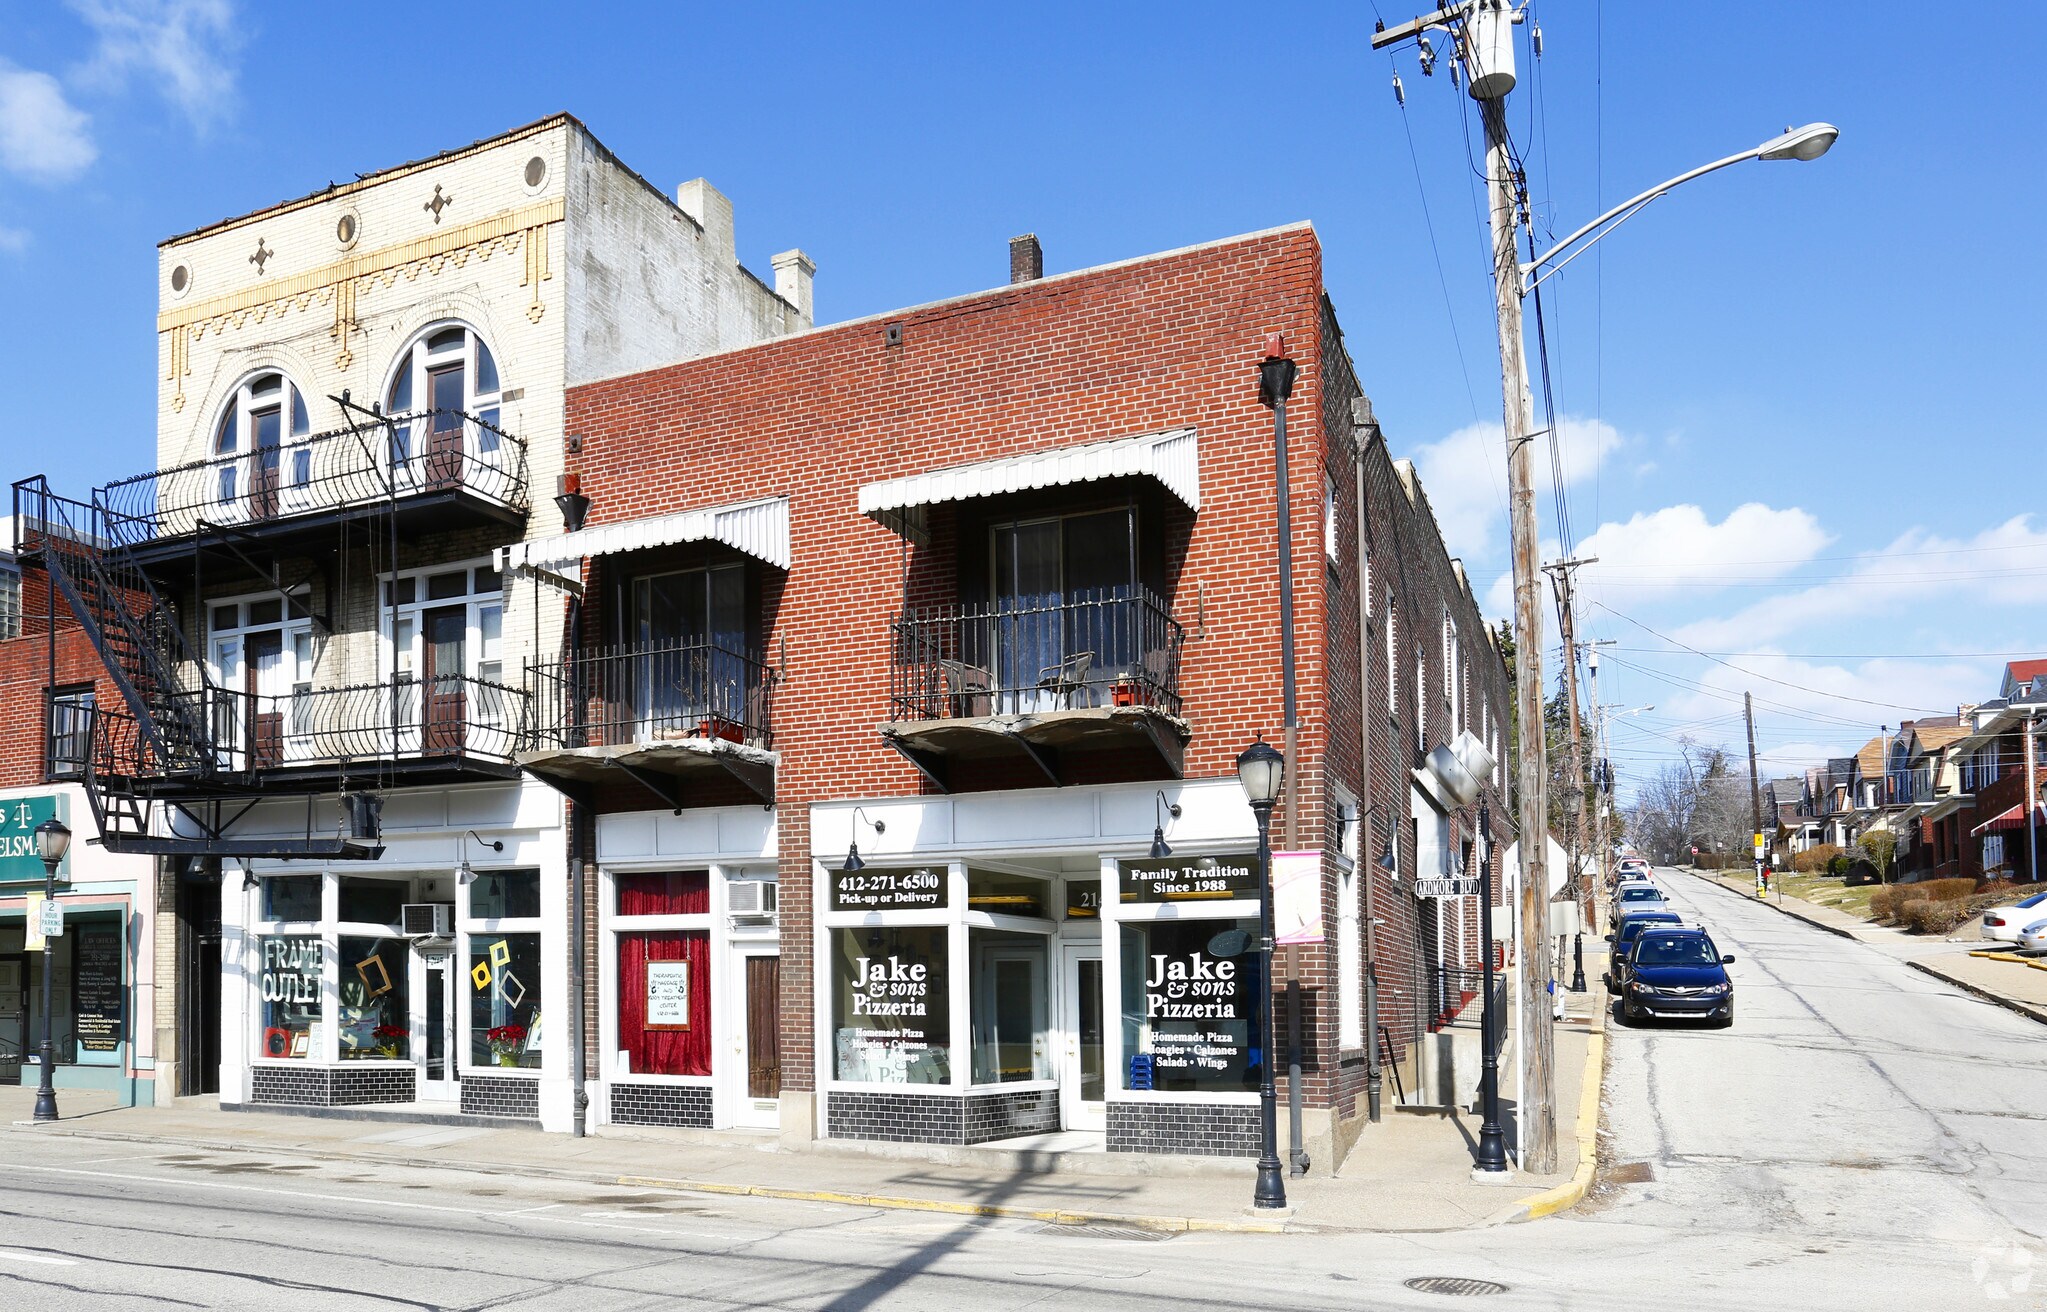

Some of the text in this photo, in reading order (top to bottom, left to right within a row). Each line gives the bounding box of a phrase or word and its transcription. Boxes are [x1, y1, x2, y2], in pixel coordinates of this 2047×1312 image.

[1131, 866, 1249, 881] Family Tradition
[839, 874, 939, 891] 412-271-6500
[1153, 880, 1227, 893] Since 1988
[1418, 880, 1479, 895] ARDMORE BLVD
[839, 892, 938, 905] Pick-up or Delivery
[48, 902, 55, 911] 2
[264, 939, 323, 969] FRAME
[852, 955, 927, 988] Jake
[1146, 952, 1235, 988] Jake
[262, 973, 323, 1003] OUTLET
[870, 982, 927, 998] & sons
[1167, 981, 1235, 998] & sons
[852, 993, 927, 1016] Pizzeria
[1146, 993, 1235, 1018] Pizzeria
[855, 1028, 924, 1038] Homemade Pizza
[1151, 1032, 1233, 1042] Homemade Pizza
[852, 1039, 928, 1051] Hoagies Calzones
[1193, 1044, 1238, 1056] Calzones
[1156, 1057, 1228, 1070] Salads Wings
